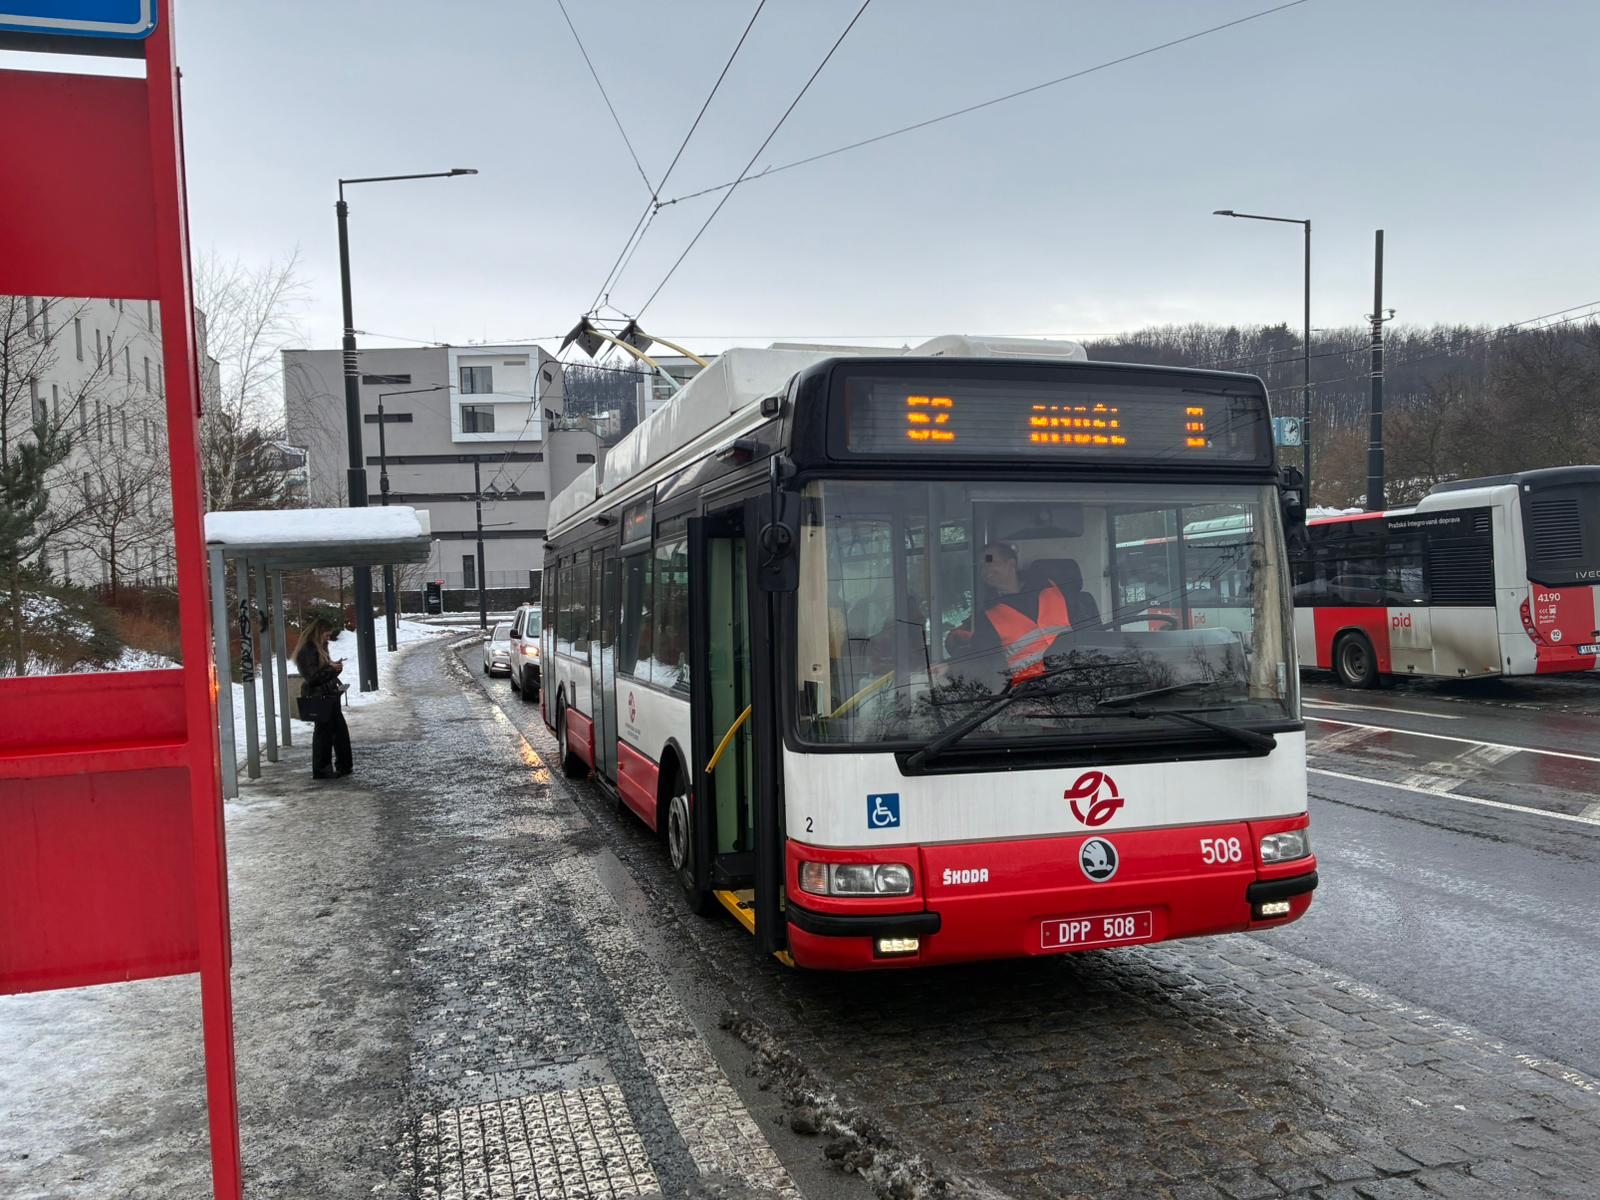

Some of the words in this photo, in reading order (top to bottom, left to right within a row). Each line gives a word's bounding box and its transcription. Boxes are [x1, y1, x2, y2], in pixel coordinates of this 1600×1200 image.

[1537, 592, 1561, 602] 4190
[1392, 612, 1411, 631] pid
[806, 816, 814, 833] 2
[1200, 837, 1242, 864] 508
[943, 868, 989, 885] ŠKODA
[1059, 921, 1091, 943] DPP
[1104, 916, 1136, 938] 508
